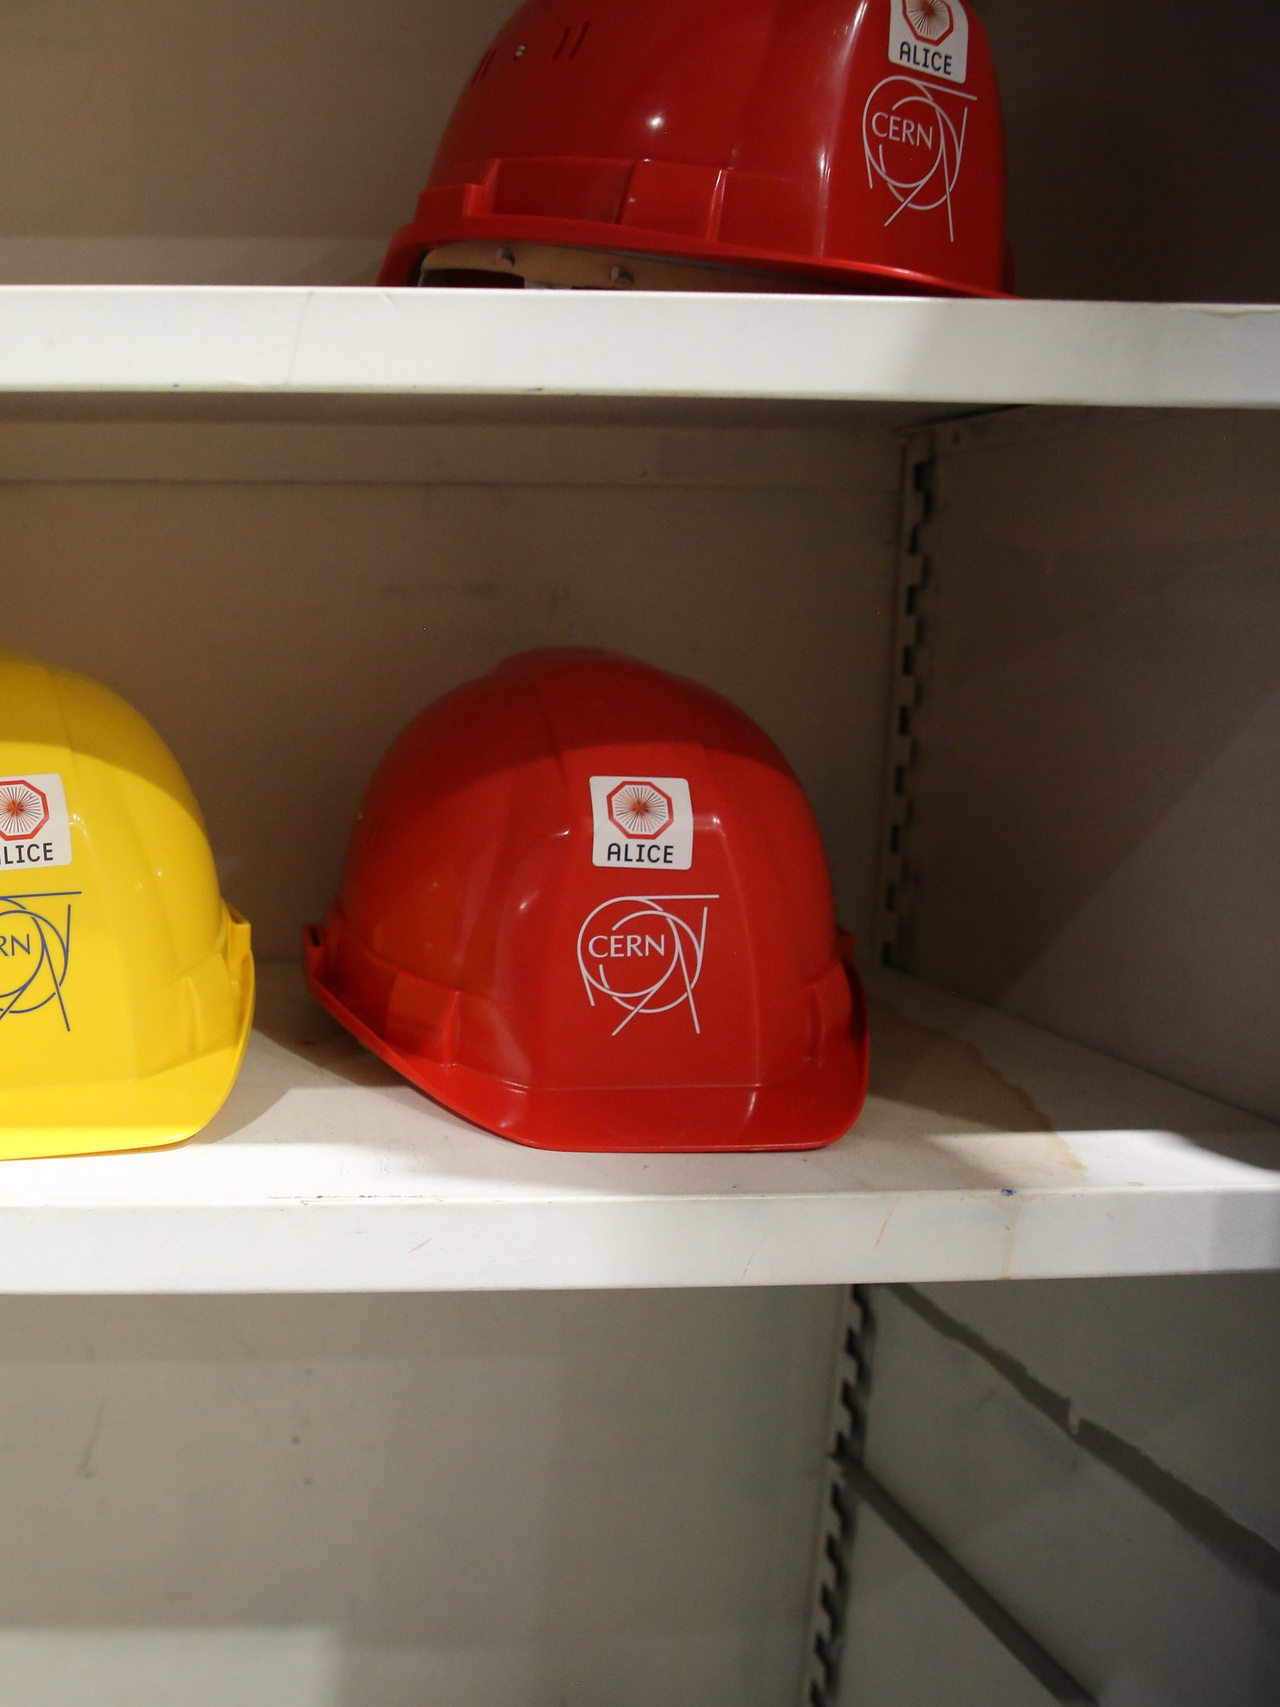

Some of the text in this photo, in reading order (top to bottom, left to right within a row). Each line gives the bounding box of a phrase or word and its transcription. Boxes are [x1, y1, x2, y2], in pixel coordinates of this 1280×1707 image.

[899, 41, 952, 75] ALICE
[871, 112, 933, 150] CERN
[607, 843, 674, 863] ALICE
[588, 934, 666, 958] CERN
